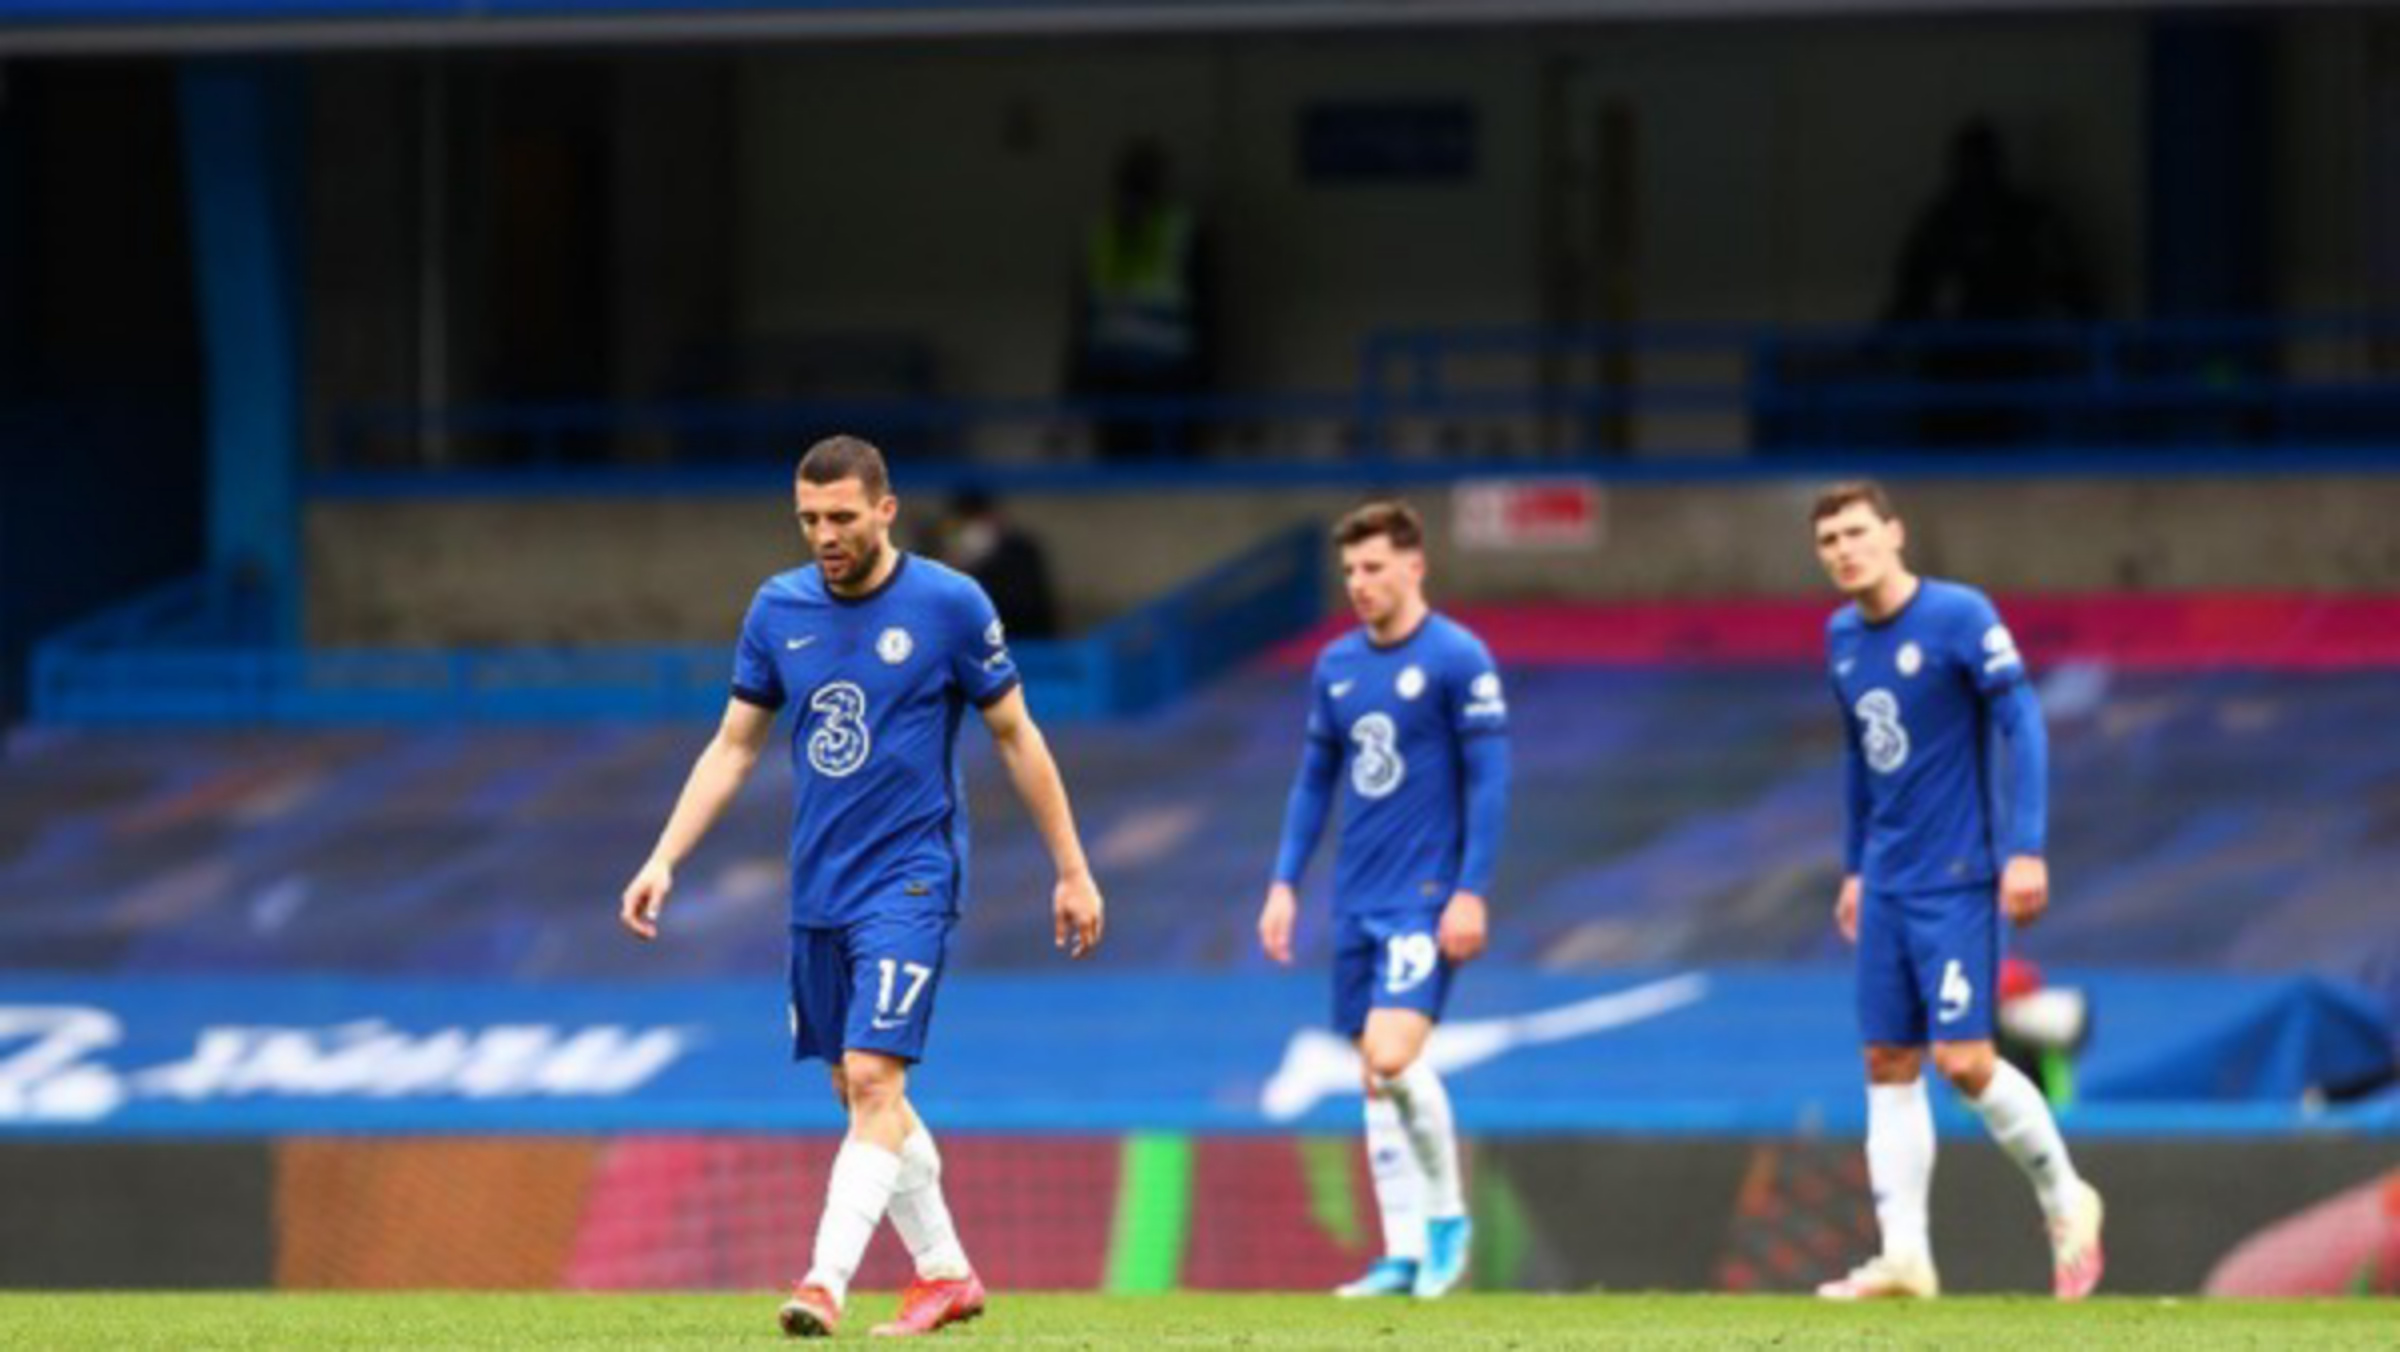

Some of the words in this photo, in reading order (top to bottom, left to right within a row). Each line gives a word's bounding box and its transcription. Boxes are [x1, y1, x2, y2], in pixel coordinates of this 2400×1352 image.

[808, 681, 870, 777] 3
[1351, 711, 1404, 799] 3
[1856, 688, 1909, 773] 3
[875, 958, 931, 1015] 17
[1386, 932, 1438, 993] 19
[1939, 959, 1972, 1023] 6
